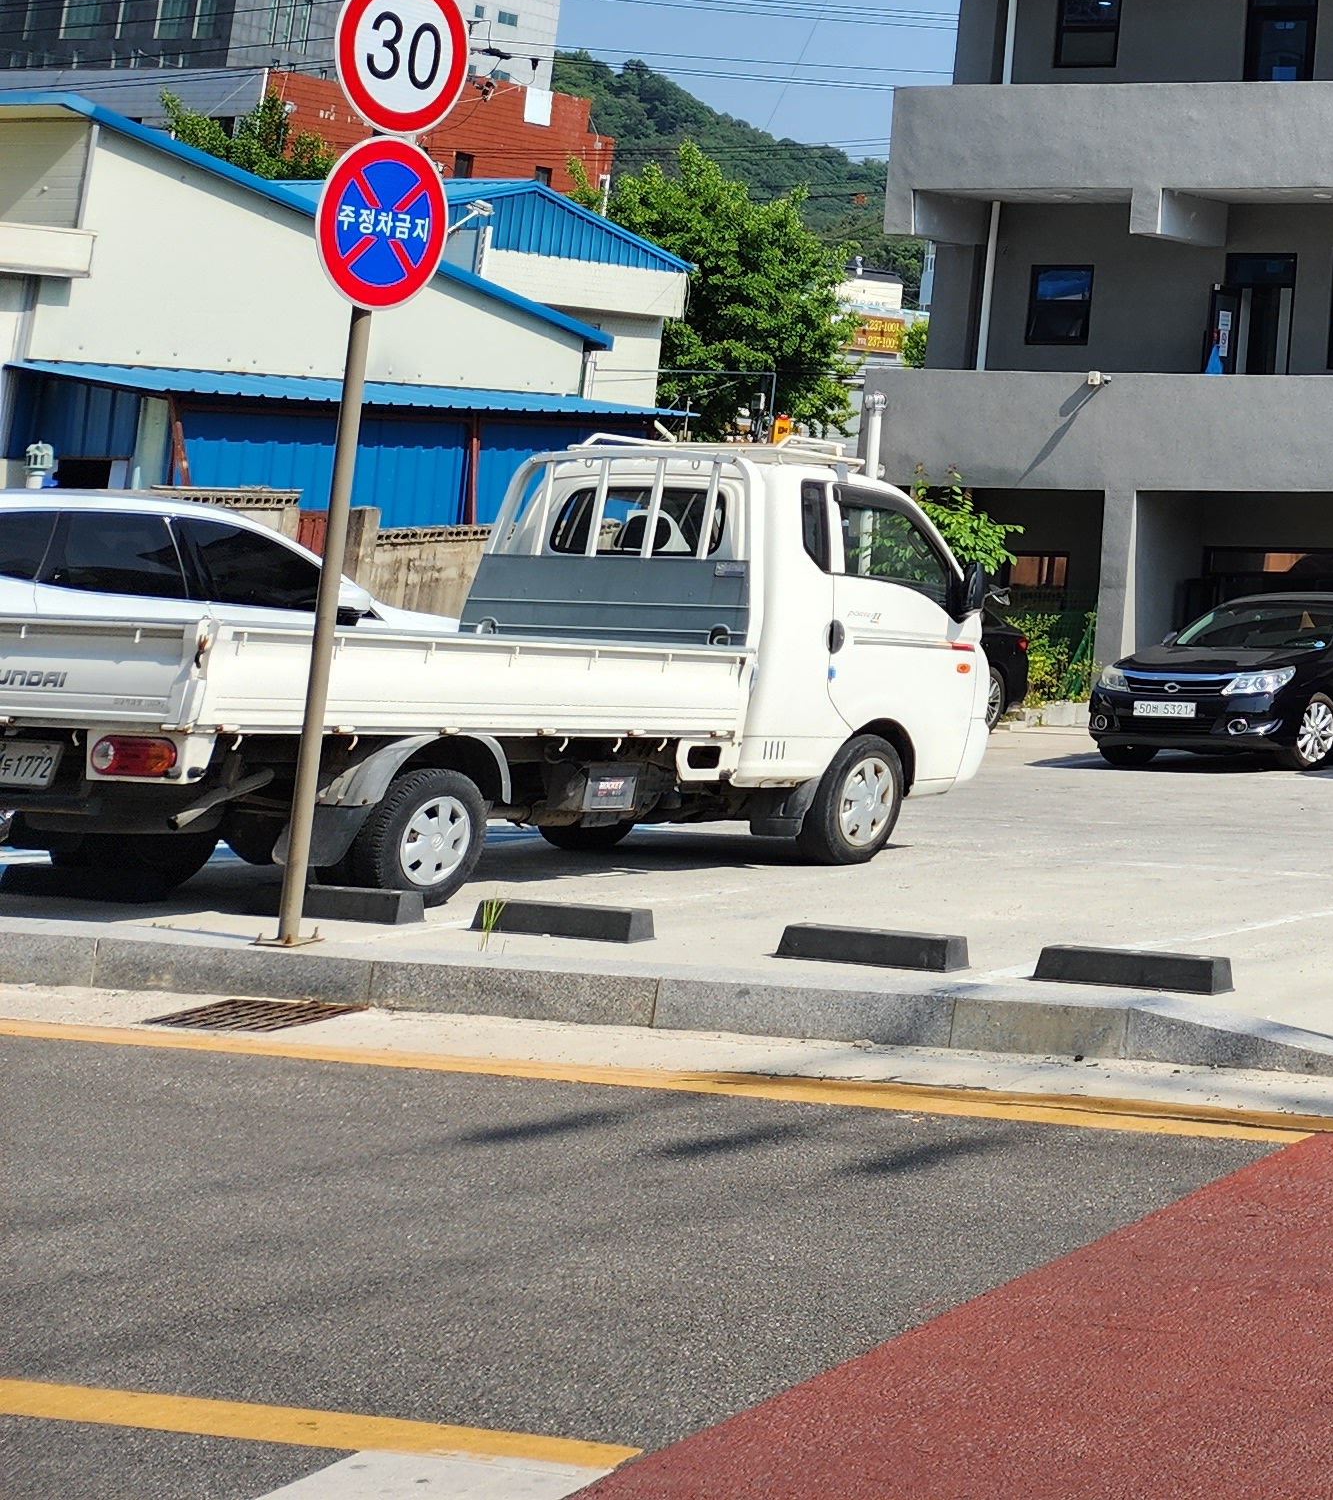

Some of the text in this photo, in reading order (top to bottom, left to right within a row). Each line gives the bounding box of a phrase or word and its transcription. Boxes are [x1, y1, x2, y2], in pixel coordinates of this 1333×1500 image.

[366, 10, 442, 90] 30
[337, 204, 430, 243] 주정차금지
[1163, 703, 1190, 715] 5321
